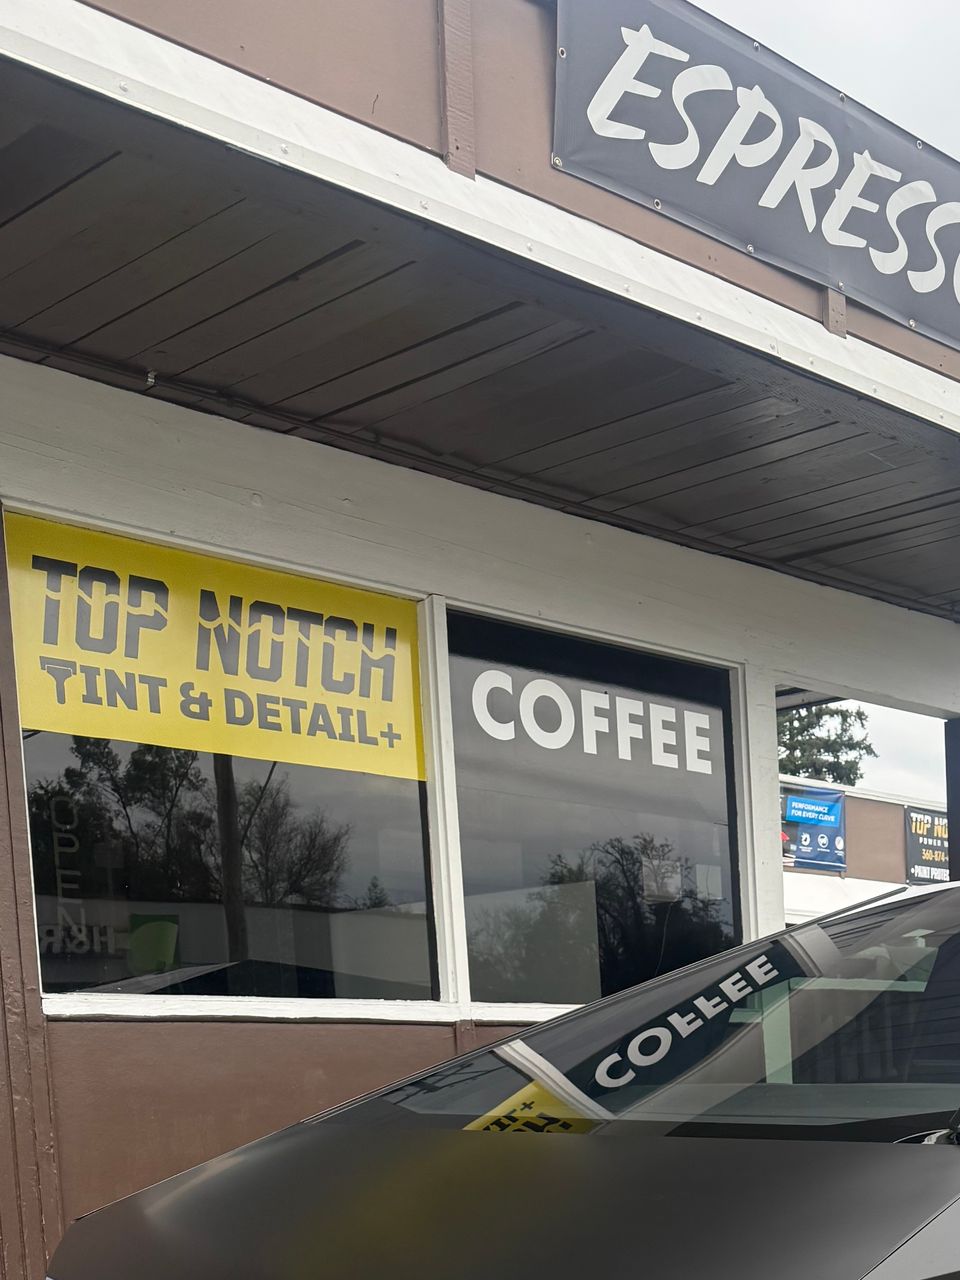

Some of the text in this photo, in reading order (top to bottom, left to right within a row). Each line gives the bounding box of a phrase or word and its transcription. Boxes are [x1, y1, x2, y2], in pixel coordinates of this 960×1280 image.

[31, 555, 397, 702] TOP NOTCH
[40, 656, 402, 749] TINT & DETAIL+
[472, 669, 713, 775] COFFEE
[910, 812, 931, 835] TOP
